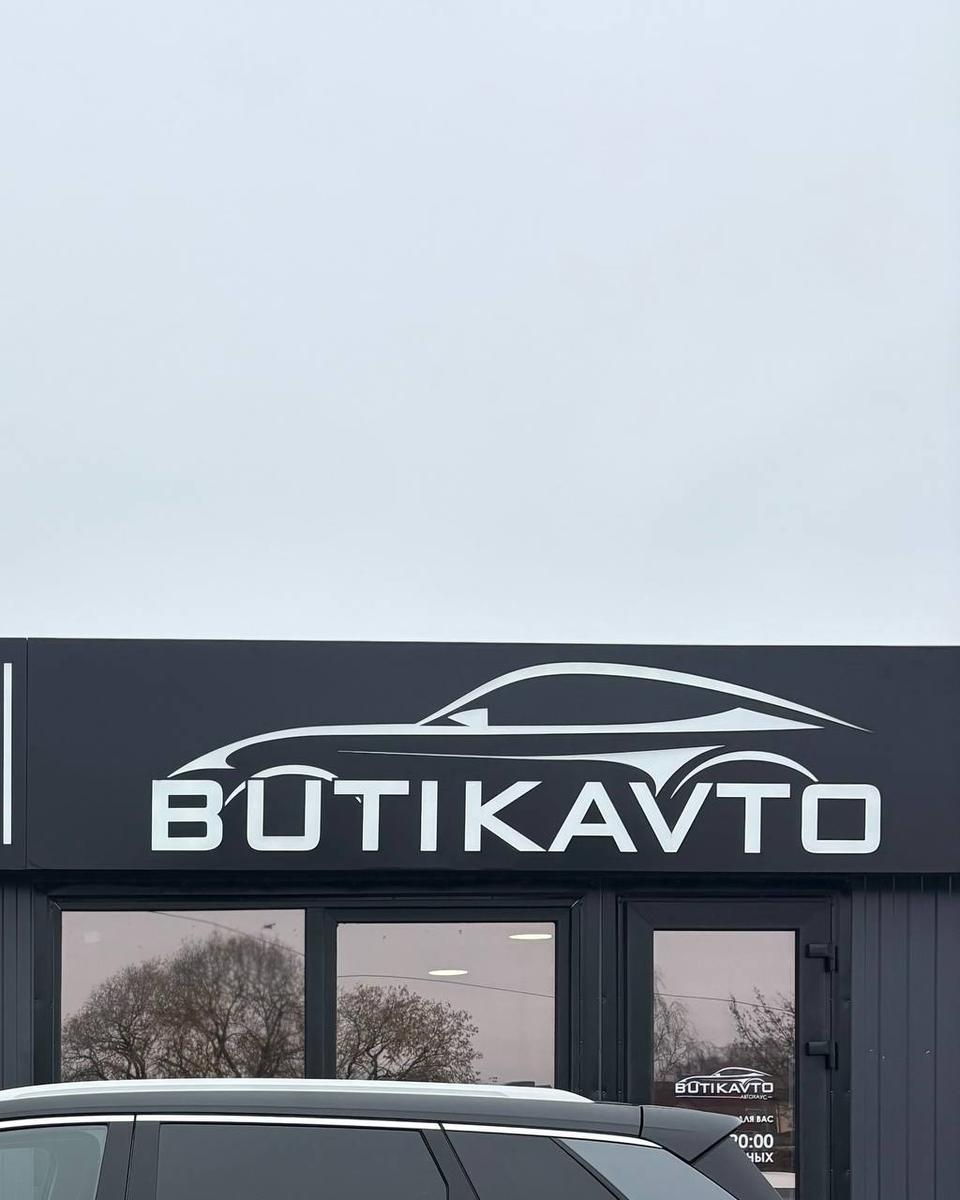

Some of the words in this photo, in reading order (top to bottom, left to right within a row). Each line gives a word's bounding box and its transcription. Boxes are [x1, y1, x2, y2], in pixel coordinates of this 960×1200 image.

[151, 778, 882, 854] BUTIKAVTO
[674, 1082, 774, 1094] BUTIKAVTO
[756, 1115, 774, 1123] ВАС
